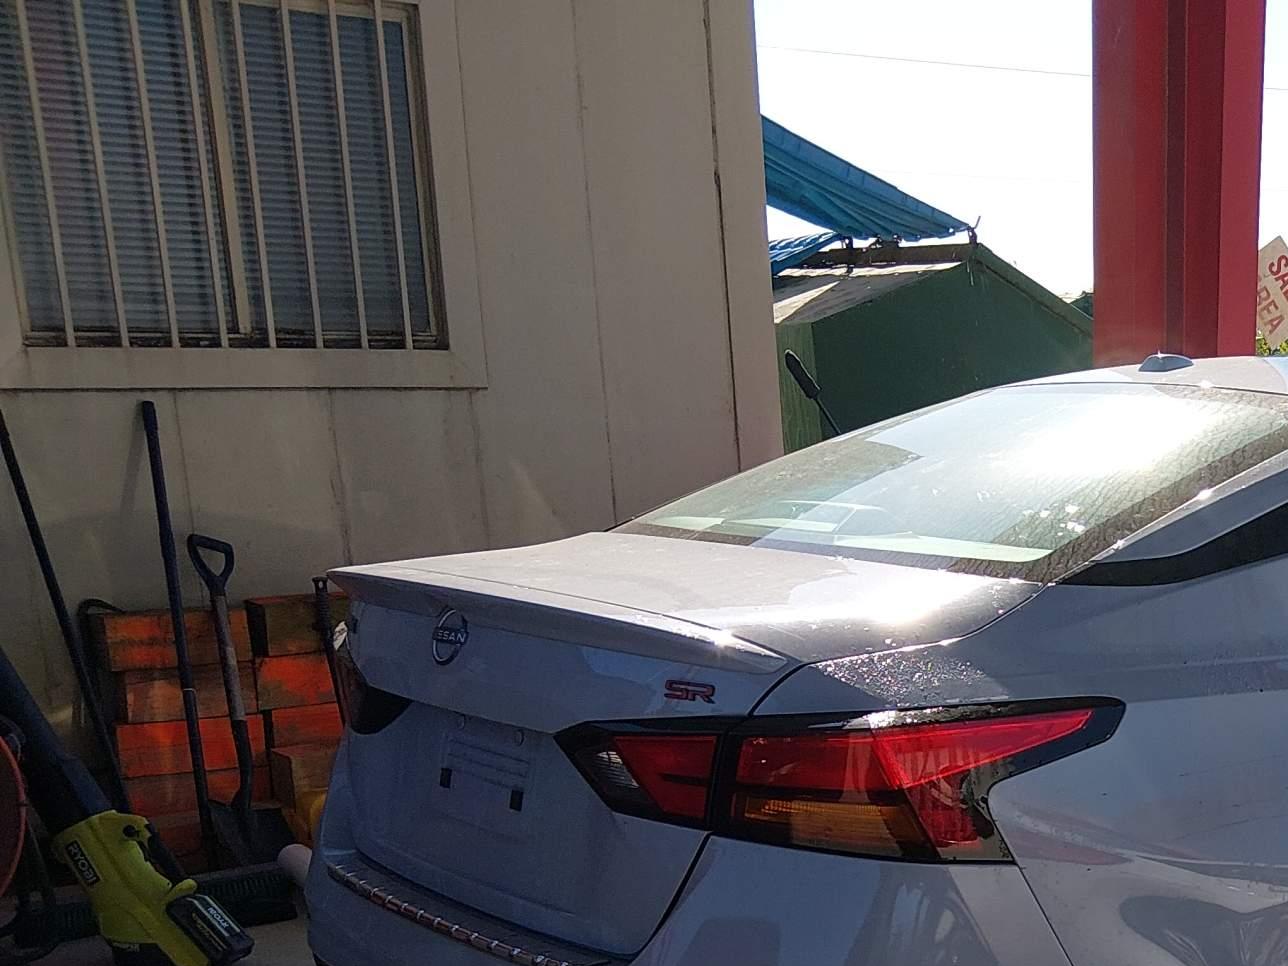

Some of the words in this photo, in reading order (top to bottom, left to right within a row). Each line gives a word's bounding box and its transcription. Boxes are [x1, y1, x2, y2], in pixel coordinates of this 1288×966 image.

[1257, 280, 1285, 335] REA
[664, 680, 716, 704] SR
[67, 842, 97, 882] RYOBI
